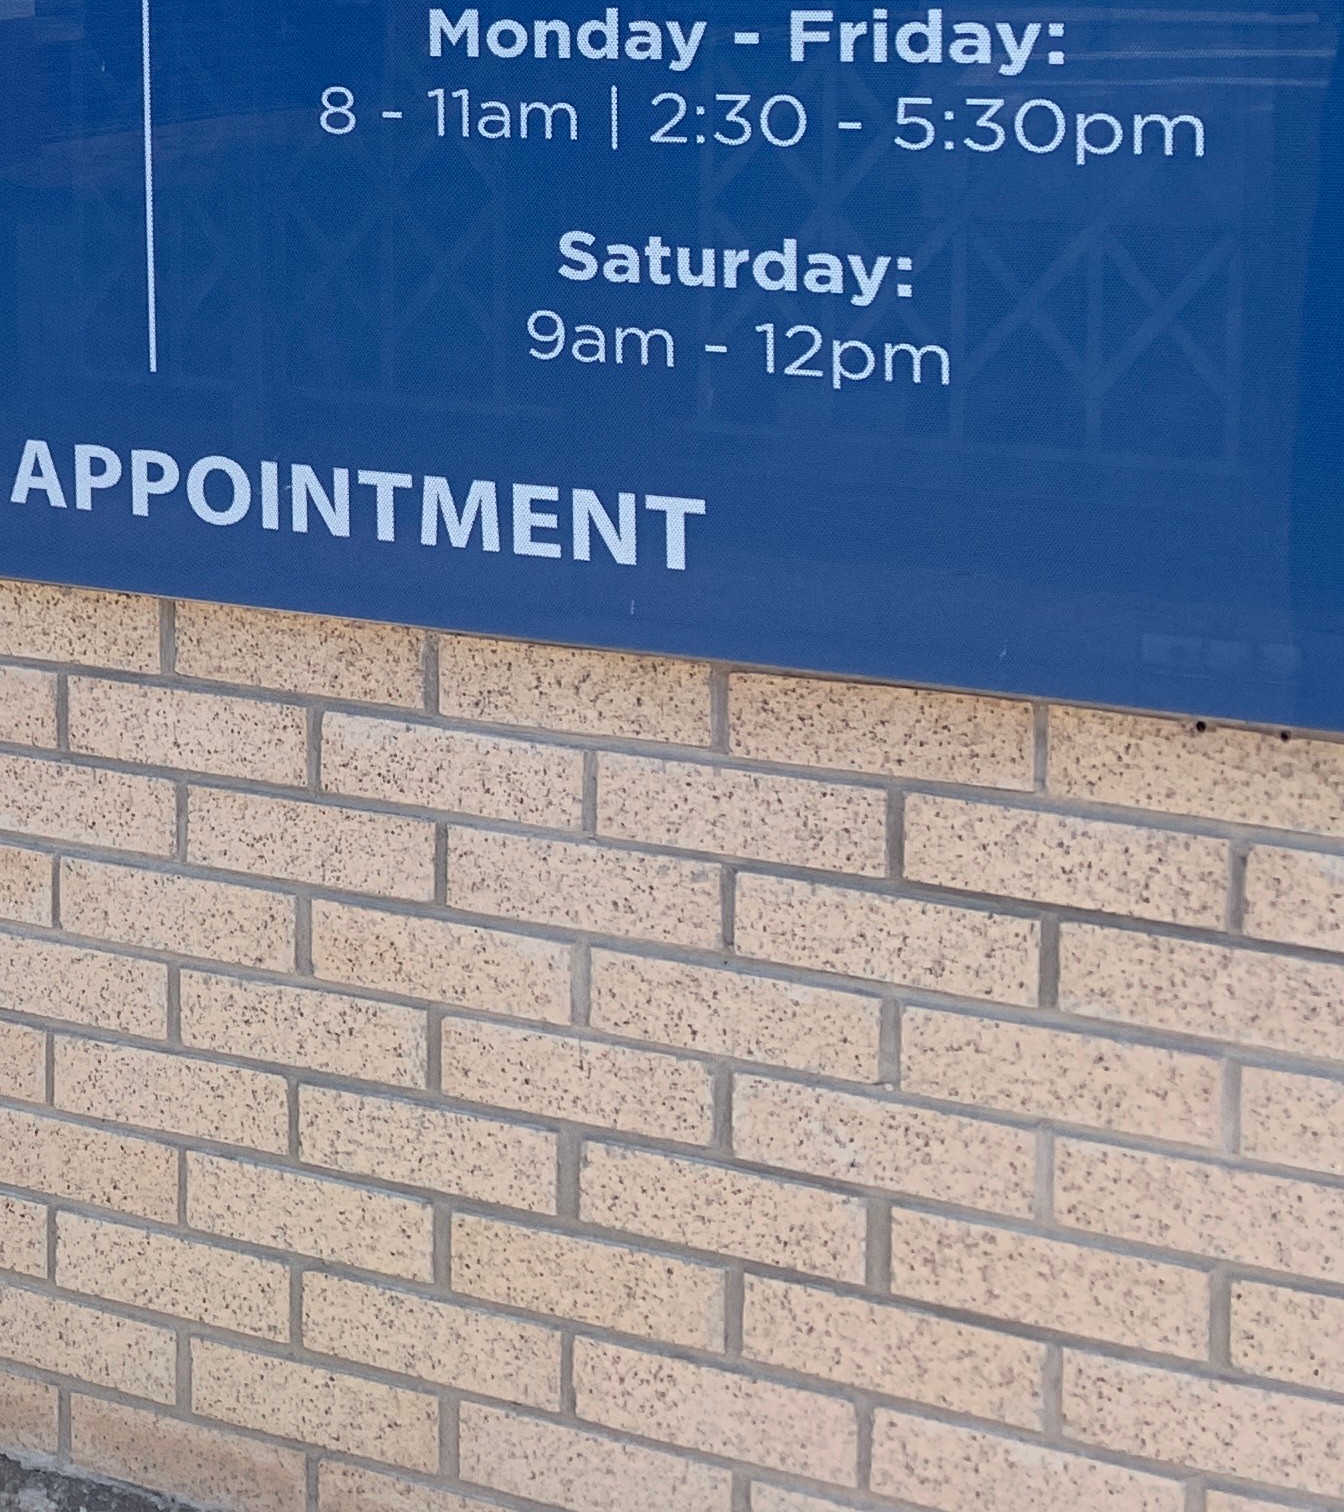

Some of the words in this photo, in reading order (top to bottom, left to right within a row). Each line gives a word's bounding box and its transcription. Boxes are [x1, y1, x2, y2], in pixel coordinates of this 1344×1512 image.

[430, 9, 706, 70] Monday
[791, 9, 1064, 75] Friday:
[321, 87, 355, 133] 8
[429, 89, 576, 139] 11am
[651, 93, 806, 146] 2:30
[895, 98, 1203, 164] 5:30pm
[560, 231, 911, 305] Saturday:
[528, 311, 673, 366] 9am
[756, 324, 948, 388] 12pm
[11, 440, 705, 569] APPOINTMENT
